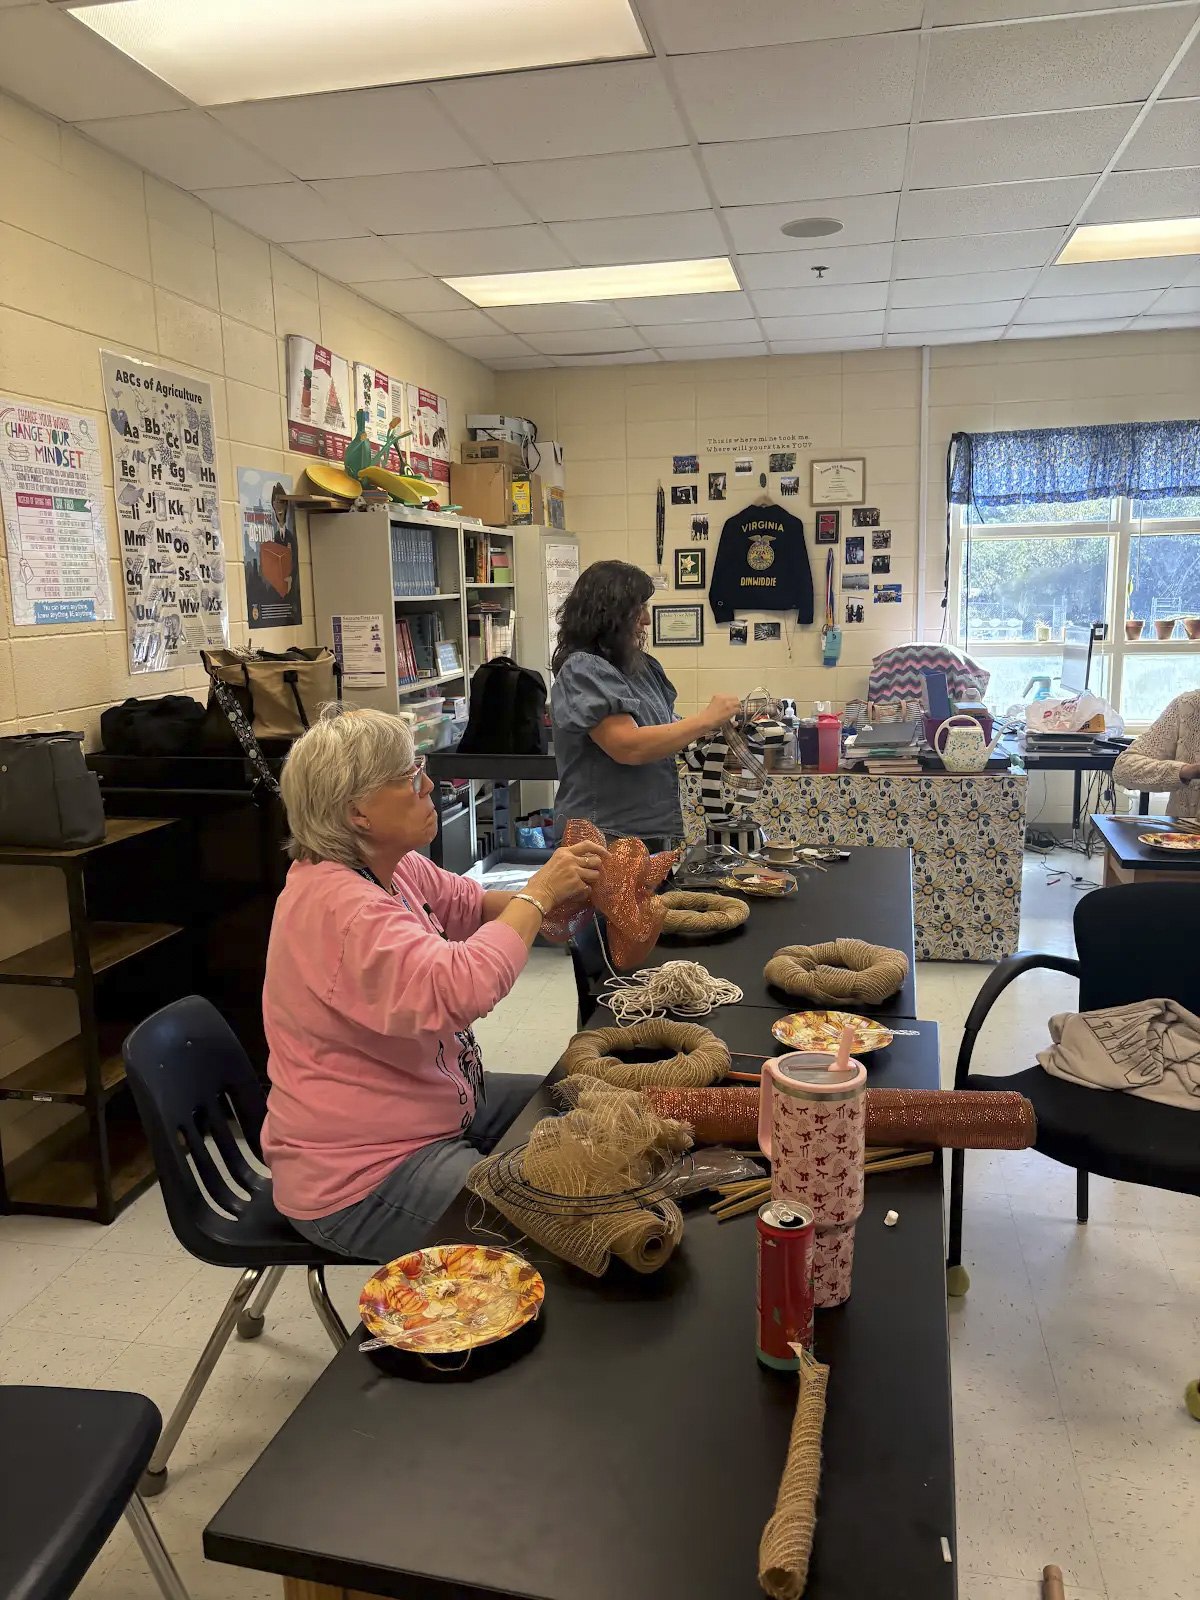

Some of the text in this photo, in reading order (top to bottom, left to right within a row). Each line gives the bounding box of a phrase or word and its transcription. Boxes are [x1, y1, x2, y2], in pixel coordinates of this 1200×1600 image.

[116, 370, 202, 404] ABCs of Agriculture
[18, 408, 38, 424] CHANGE
[5, 422, 70, 447] CHANGE YOUR
[124, 422, 140, 439] Aa
[144, 418, 160, 435] Bb
[166, 432, 180, 449] Cc
[184, 429, 199, 446] Dd
[34, 445, 84, 469] MINDSET
[121, 460, 136, 478] Ee
[151, 464, 162, 480] Ff
[170, 462, 186, 483] Gg
[200, 466, 216, 483] Hh
[146, 492, 156, 513] Jj
[169, 500, 184, 515] Kk
[249, 524, 274, 542] ACTION!
[742, 520, 784, 532] VIRGINIA
[124, 530, 146, 546] Mm
[156, 528, 172, 544] Nn
[205, 531, 219, 550] Pp
[174, 538, 189, 554] Oo
[149, 559, 162, 574] Rr
[179, 566, 190, 582] Ss
[200, 564, 211, 579] Tt
[126, 570, 143, 590] Qq
[740, 576, 776, 587] DINWIDDIE
[161, 588, 176, 603] Vv
[136, 604, 152, 620] Uu
[179, 598, 200, 614] Ww
[208, 597, 223, 612] Xx
